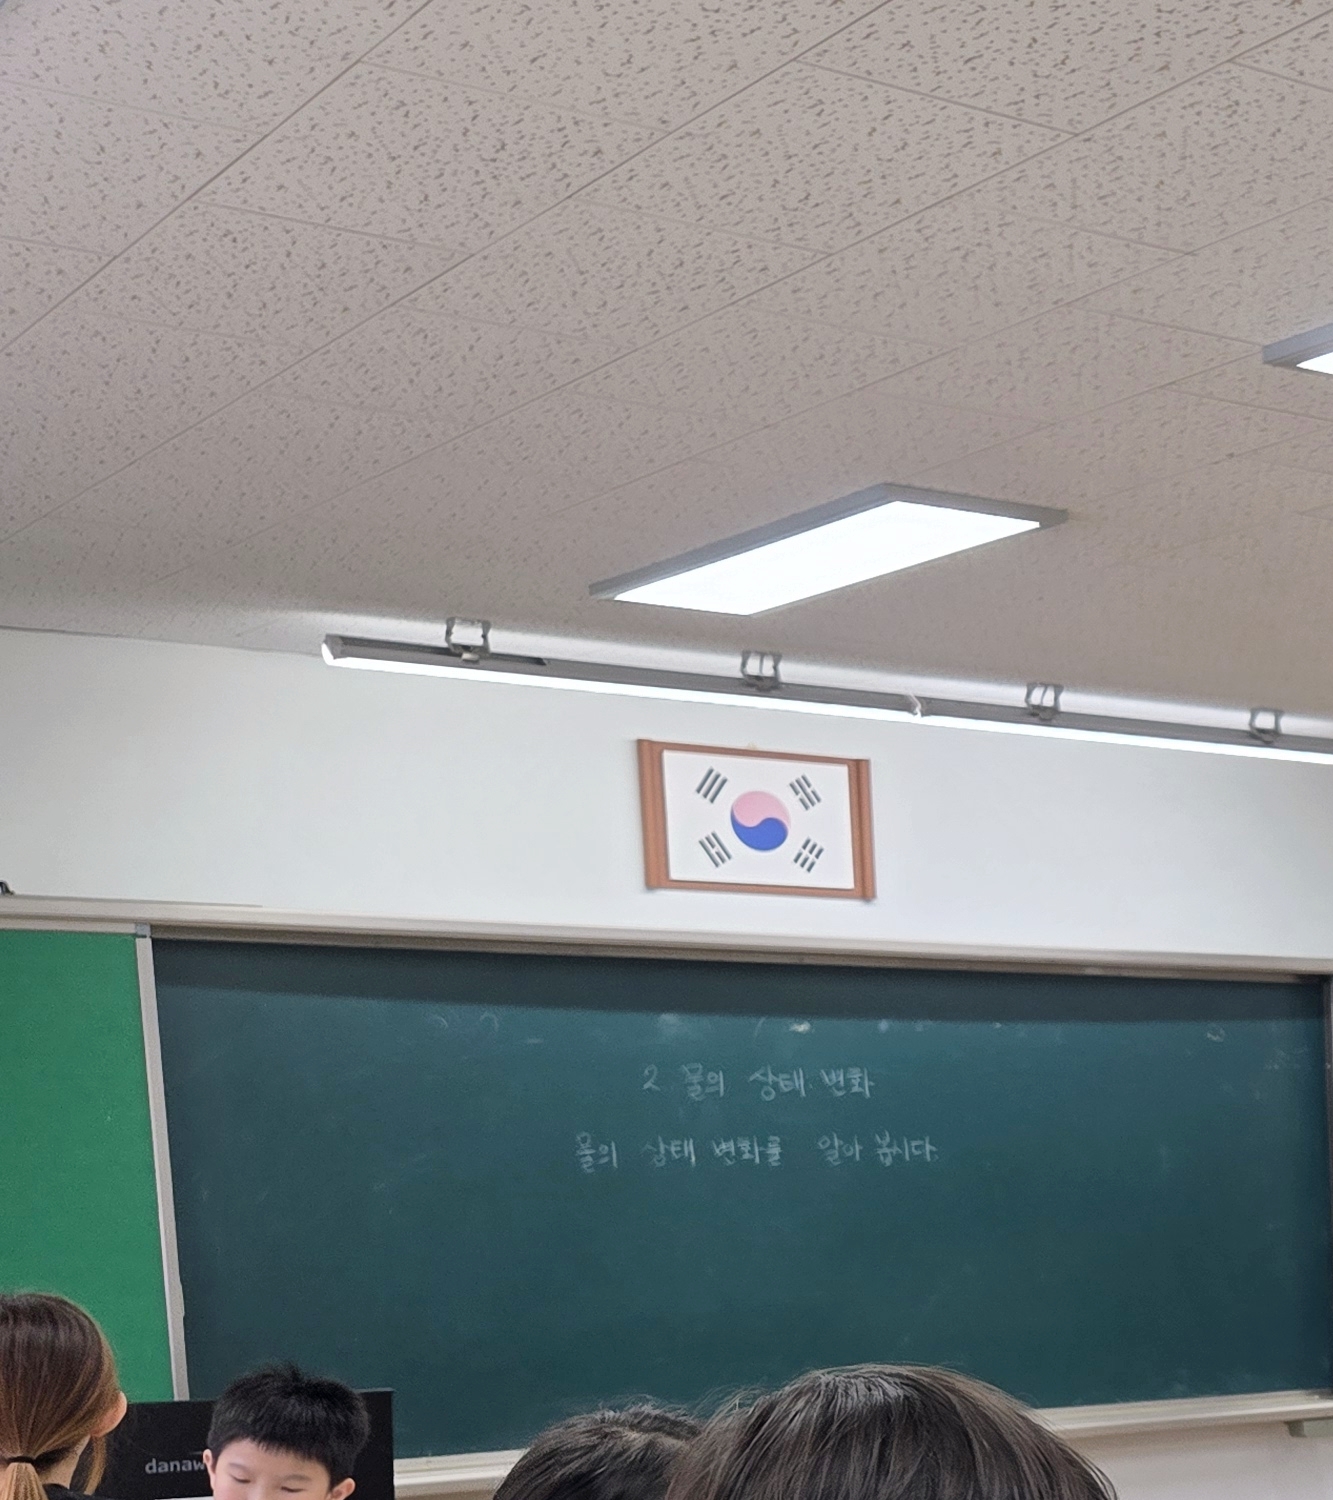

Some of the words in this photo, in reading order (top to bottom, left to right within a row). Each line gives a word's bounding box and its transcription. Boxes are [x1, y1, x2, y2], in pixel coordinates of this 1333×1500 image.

[642, 1064, 661, 1091] 2
[681, 1063, 724, 1101] 물의
[749, 1064, 807, 1101] 상태
[820, 1067, 875, 1099] 변화
[575, 1132, 618, 1174] 물의
[642, 1136, 696, 1168] 상태
[712, 1135, 783, 1167] 변화를
[817, 1132, 863, 1167] 알아
[145, 1458, 206, 1474] danaw
